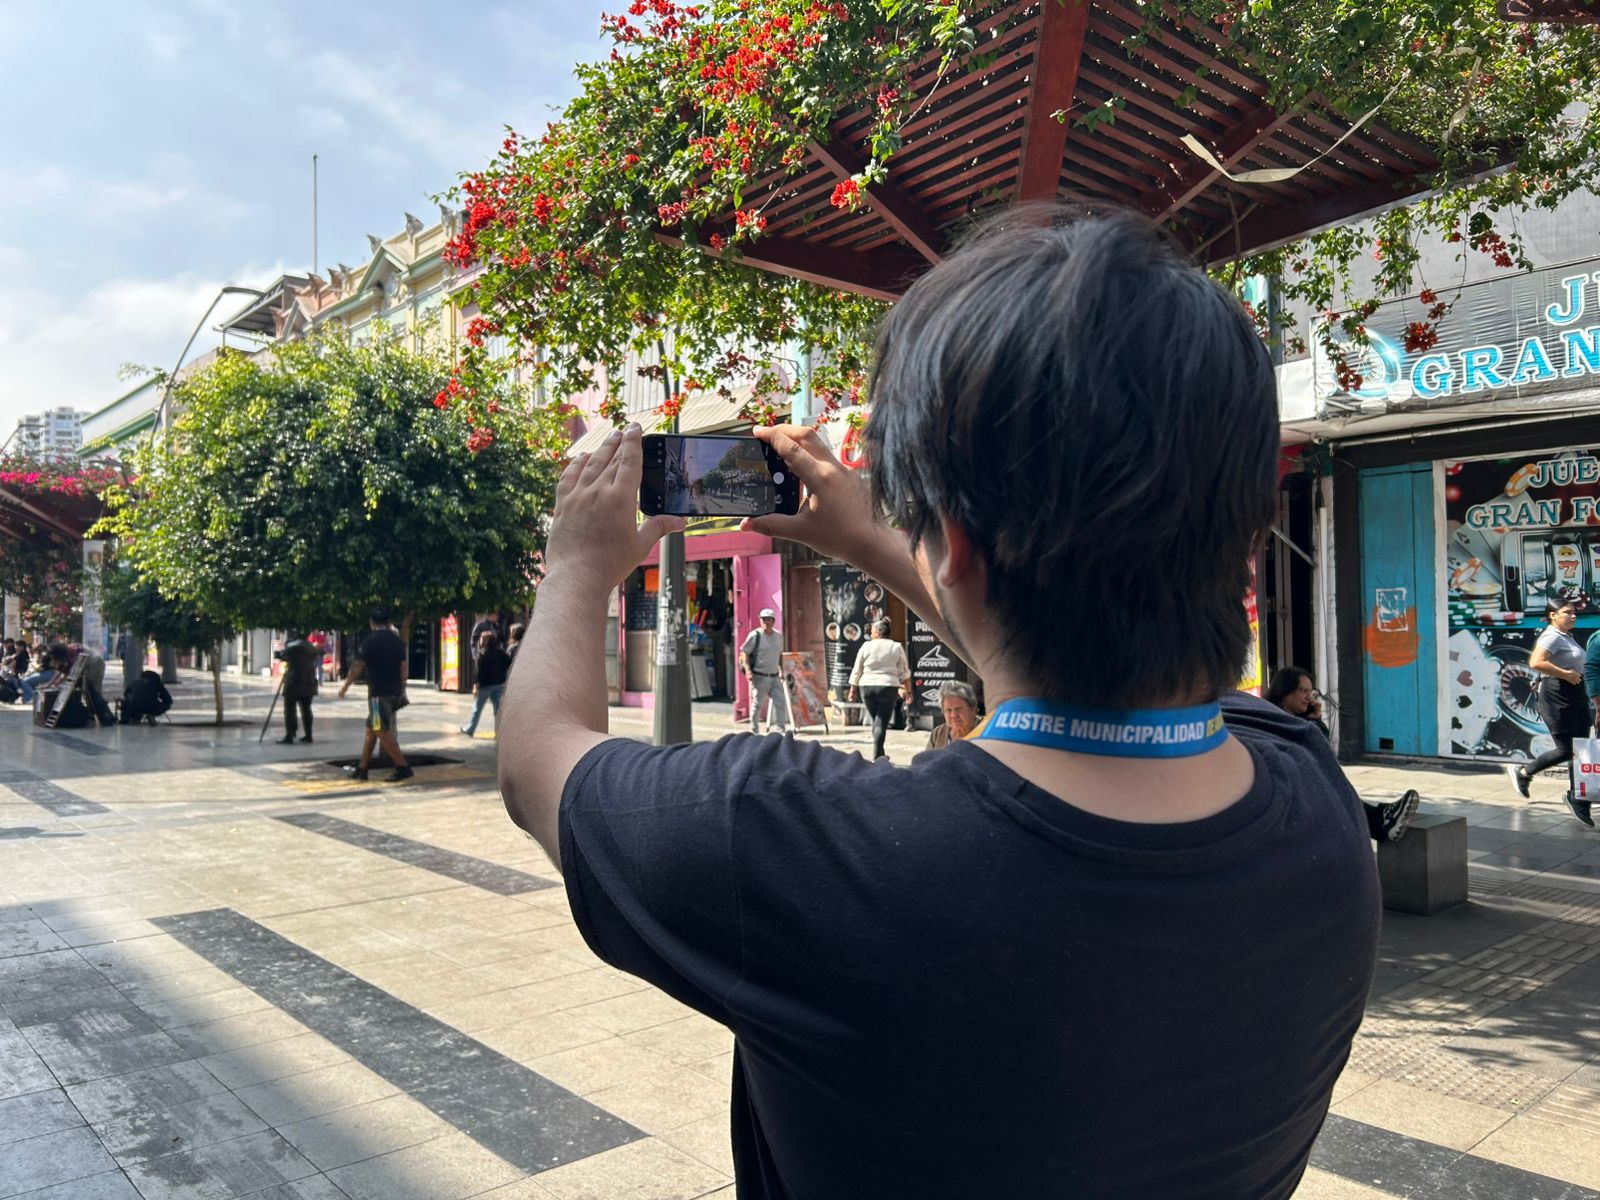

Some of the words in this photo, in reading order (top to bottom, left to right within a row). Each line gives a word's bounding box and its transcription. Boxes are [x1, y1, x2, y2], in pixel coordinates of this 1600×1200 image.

[1465, 499, 1562, 530] GRAN
[1571, 496, 1600, 525] F
[996, 712, 1065, 734] ILUSTRE
[1070, 719, 1204, 743] MUNICIPALIDAD
